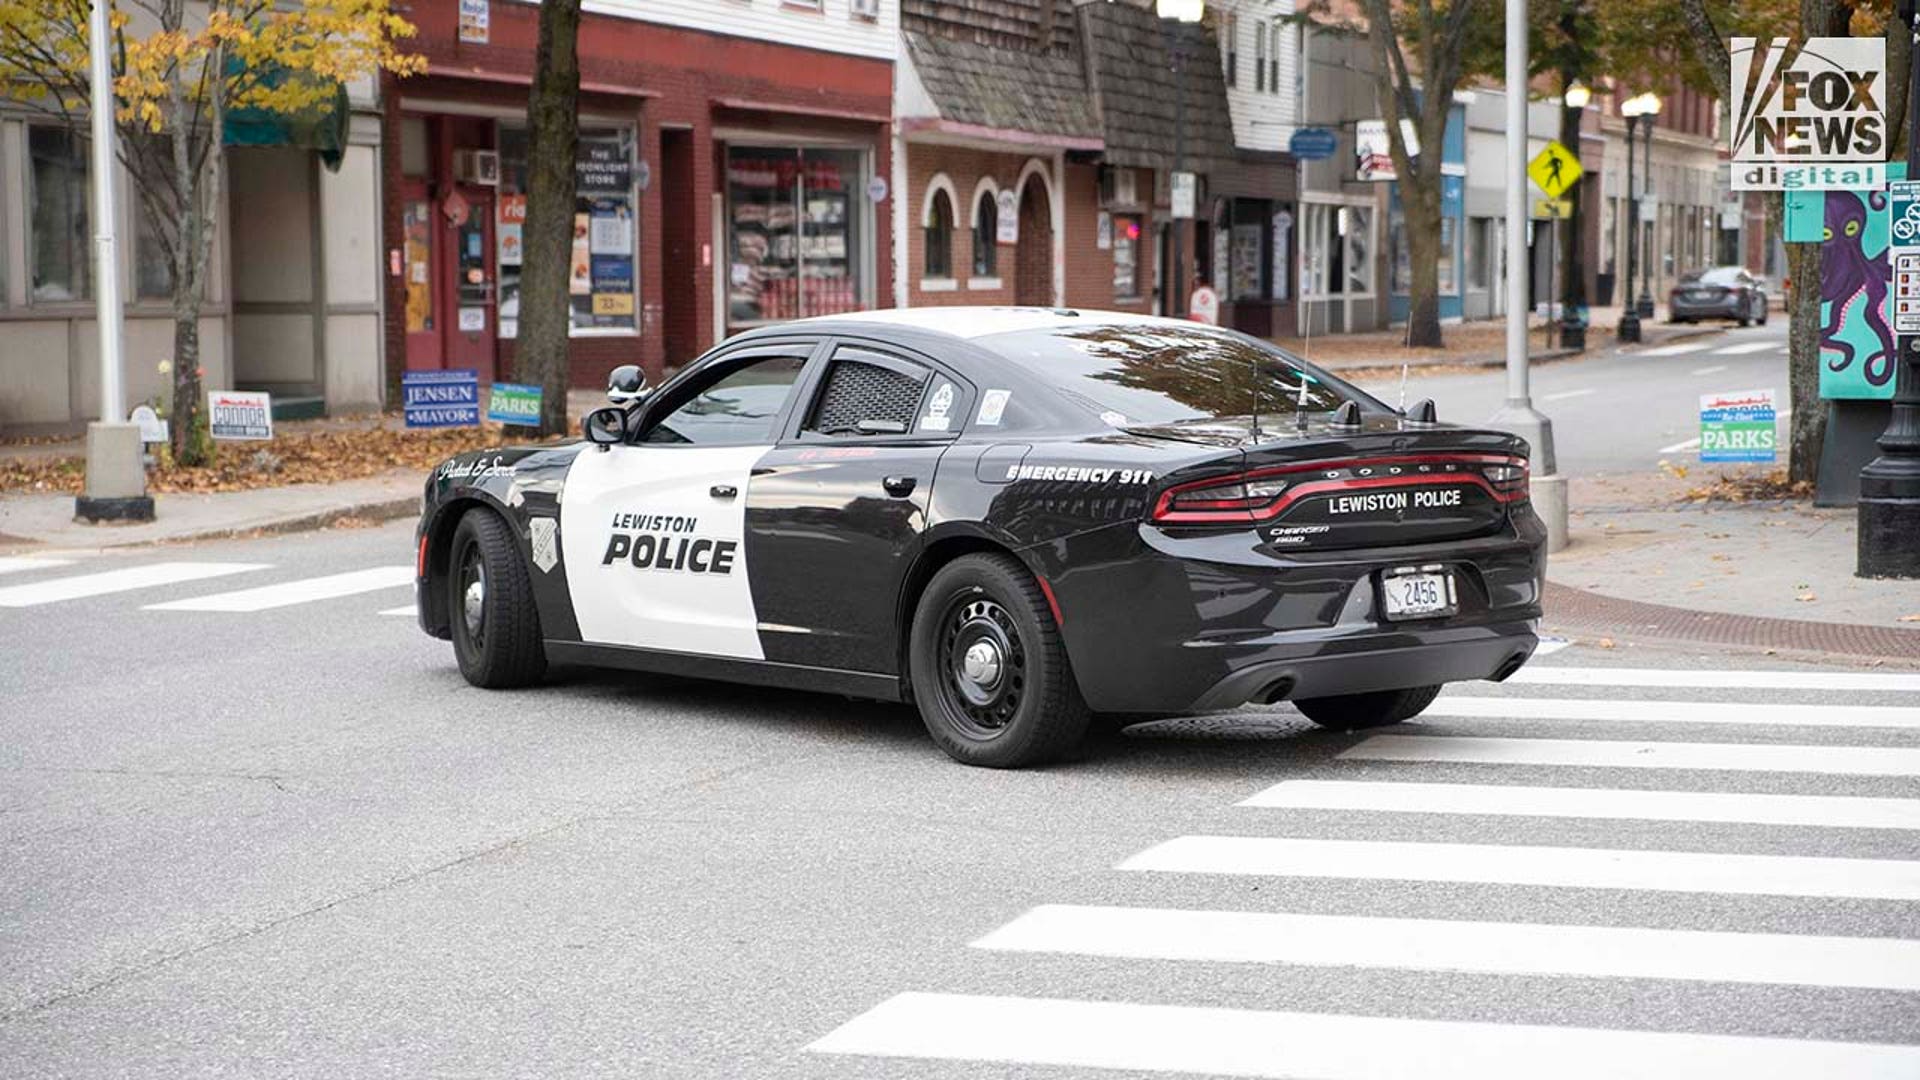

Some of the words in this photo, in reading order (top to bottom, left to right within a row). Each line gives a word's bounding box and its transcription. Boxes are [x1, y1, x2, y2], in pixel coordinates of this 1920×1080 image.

[590, 150, 609, 160] THE
[584, 174, 616, 185] STORE
[407, 386, 471, 405] JENSEN
[490, 396, 539, 415] PARKS
[413, 410, 469, 423] MAYOR
[1702, 429, 1774, 450] PARKS
[1006, 465, 1117, 483] EMERGENCY
[1118, 469, 1153, 485] 911
[1327, 464, 1457, 478] DODGE
[1329, 492, 1408, 514] LEWISTON
[1414, 489, 1461, 508] POLICE
[612, 512, 697, 533] LEWISTON
[1269, 524, 1331, 537] CHARGER
[602, 533, 738, 574] POLICE
[1404, 580, 1437, 606] 2456
